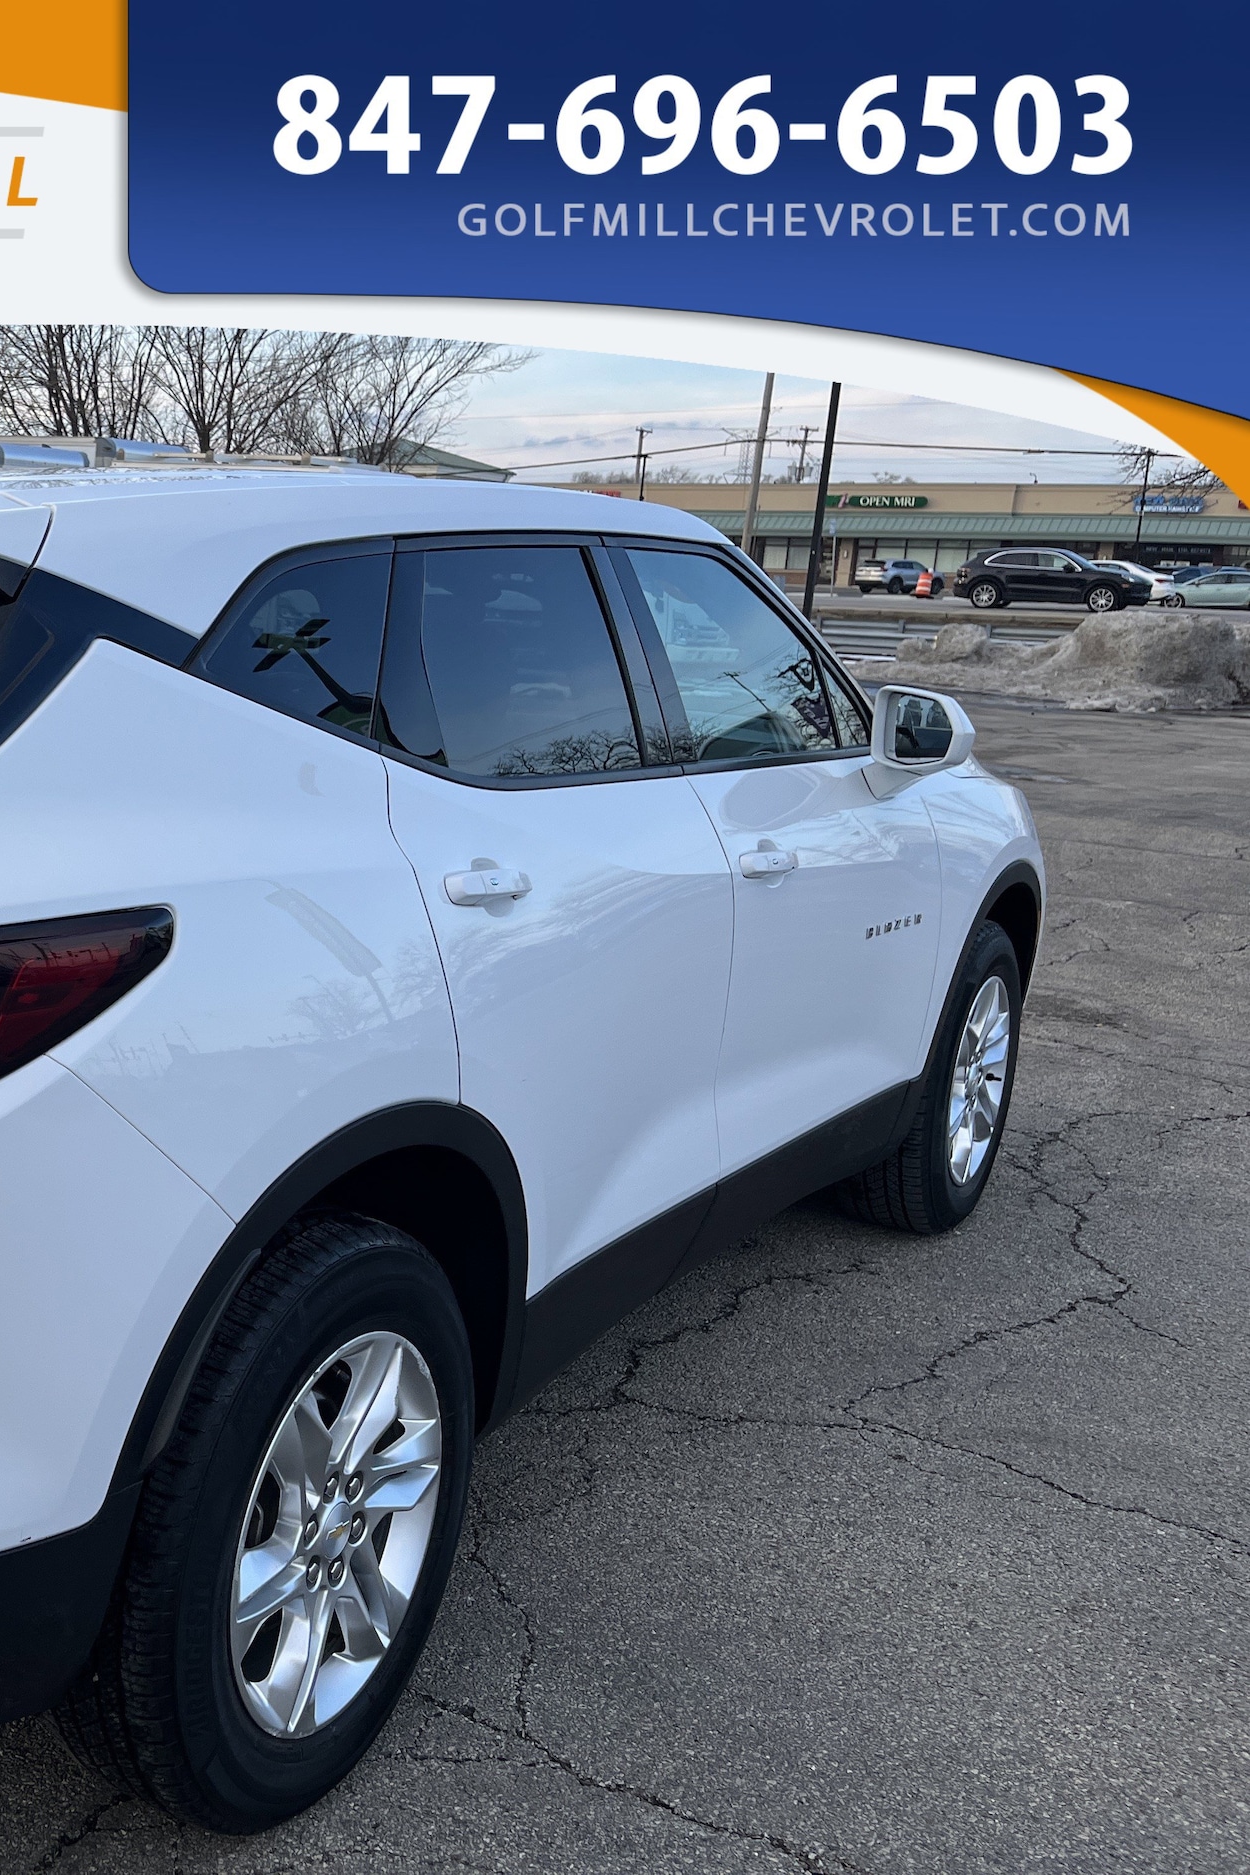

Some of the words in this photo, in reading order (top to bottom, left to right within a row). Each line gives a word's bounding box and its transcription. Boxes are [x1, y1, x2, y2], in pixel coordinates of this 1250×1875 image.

[859, 496, 890, 507] OPEN
[894, 496, 916, 507] MRI
[865, 913, 923, 940] BLAZER
